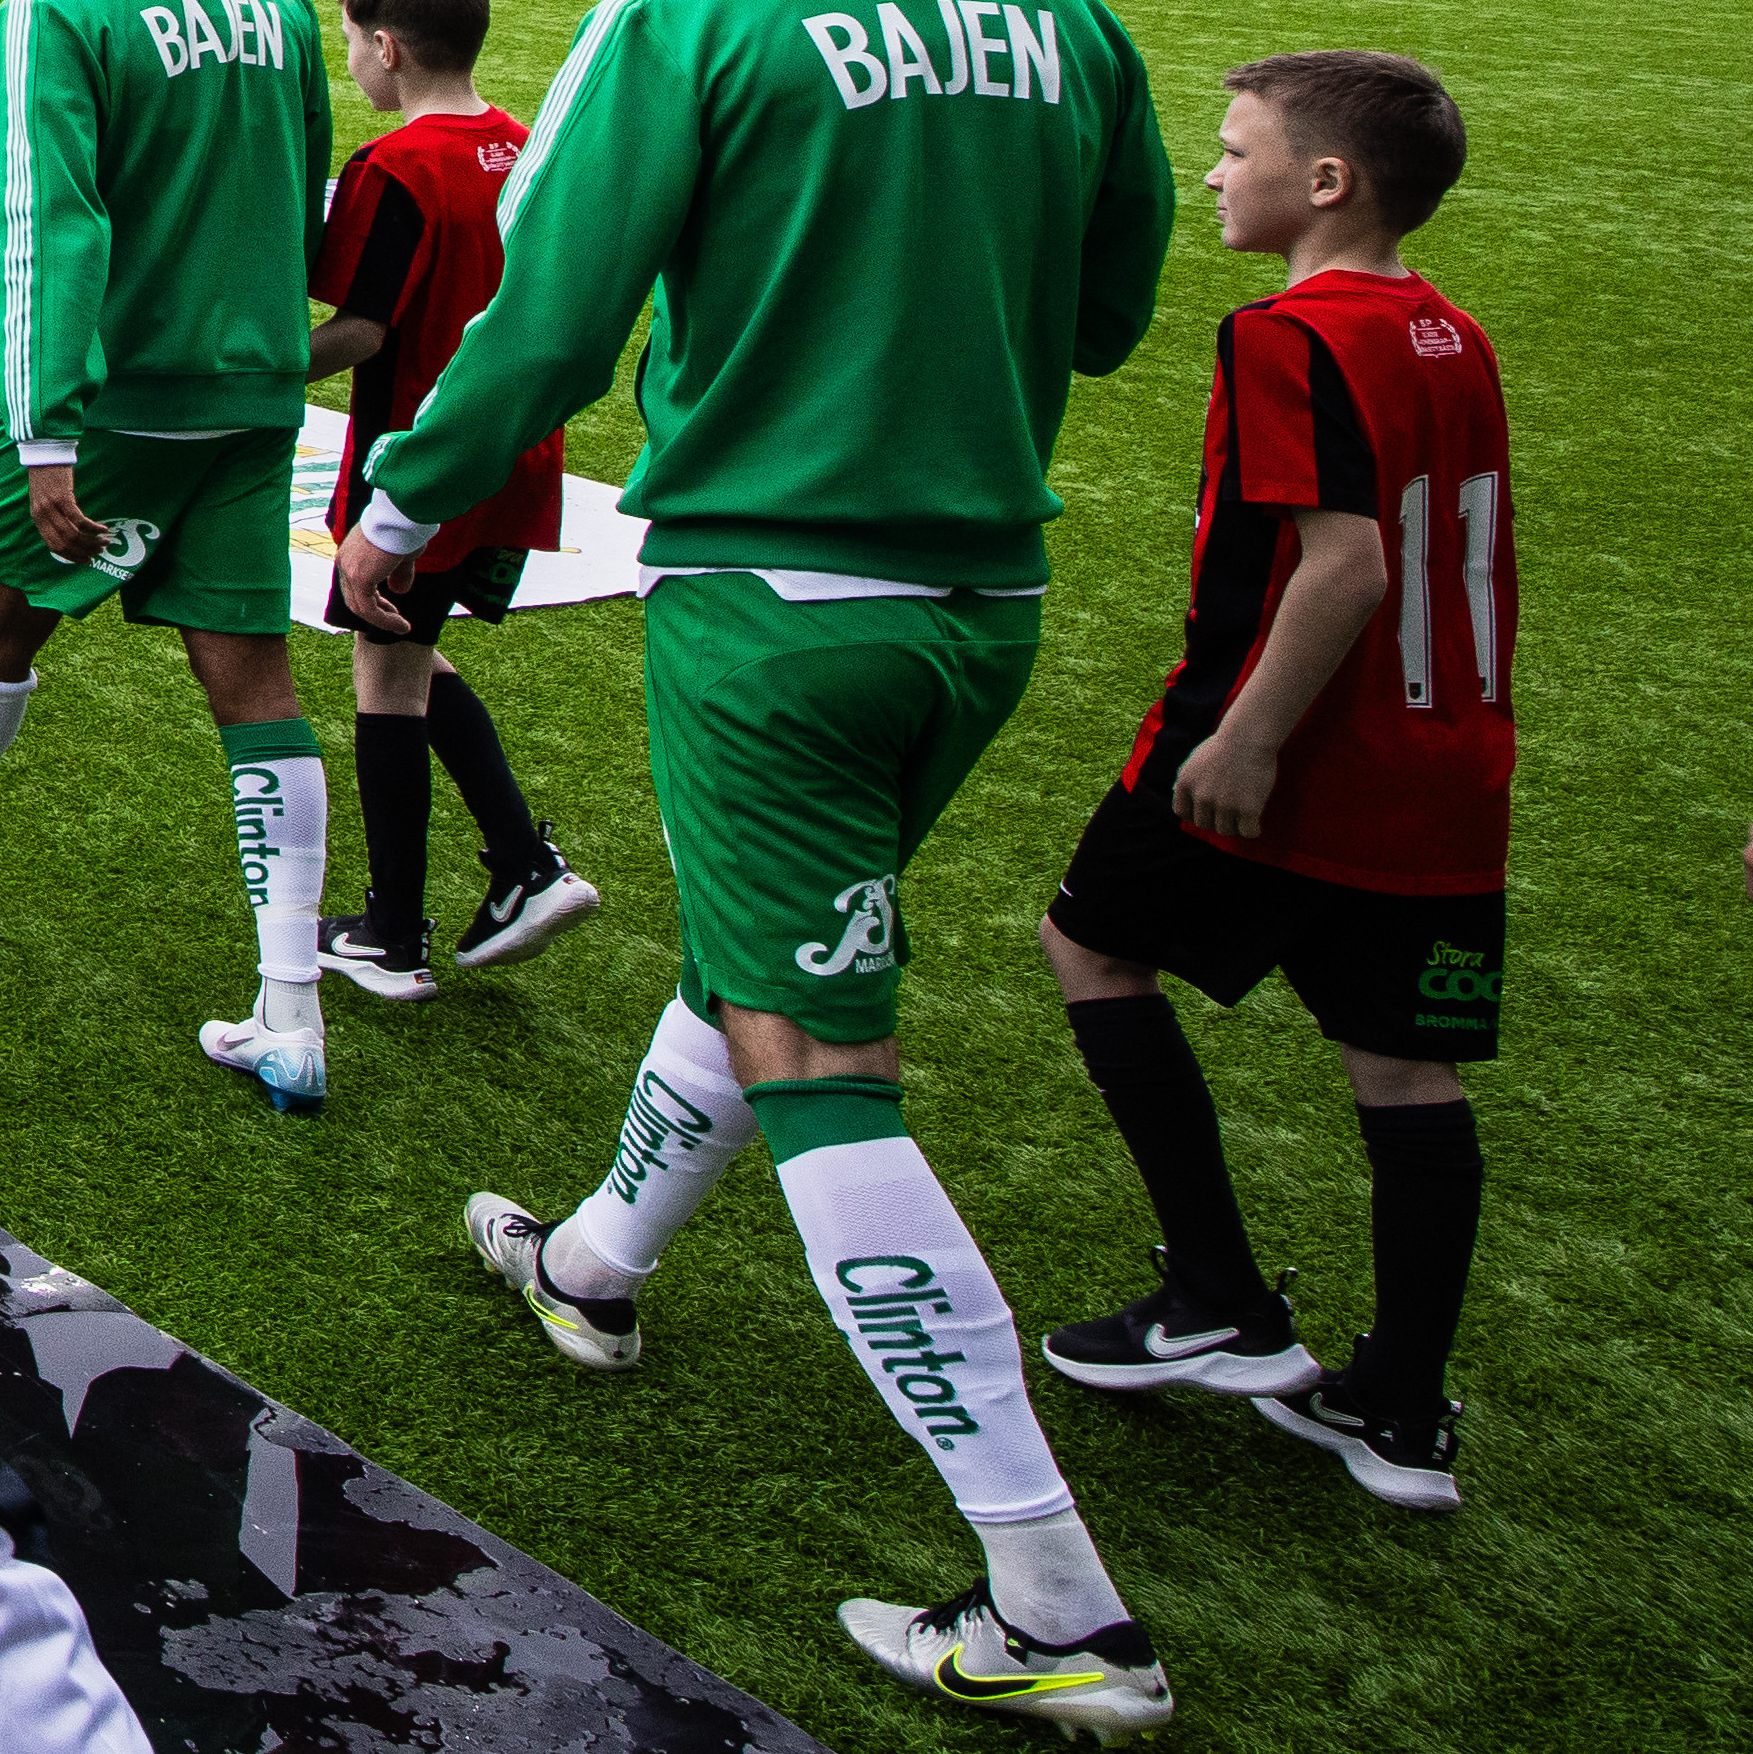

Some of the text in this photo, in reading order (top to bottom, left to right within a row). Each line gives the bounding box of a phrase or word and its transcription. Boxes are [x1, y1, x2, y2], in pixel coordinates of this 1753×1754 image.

[1400, 472, 1499, 709] 11
[232, 768, 285, 907] Clinton
[1426, 940, 1485, 967] Stora
[610, 1070, 713, 1205] Clinton
